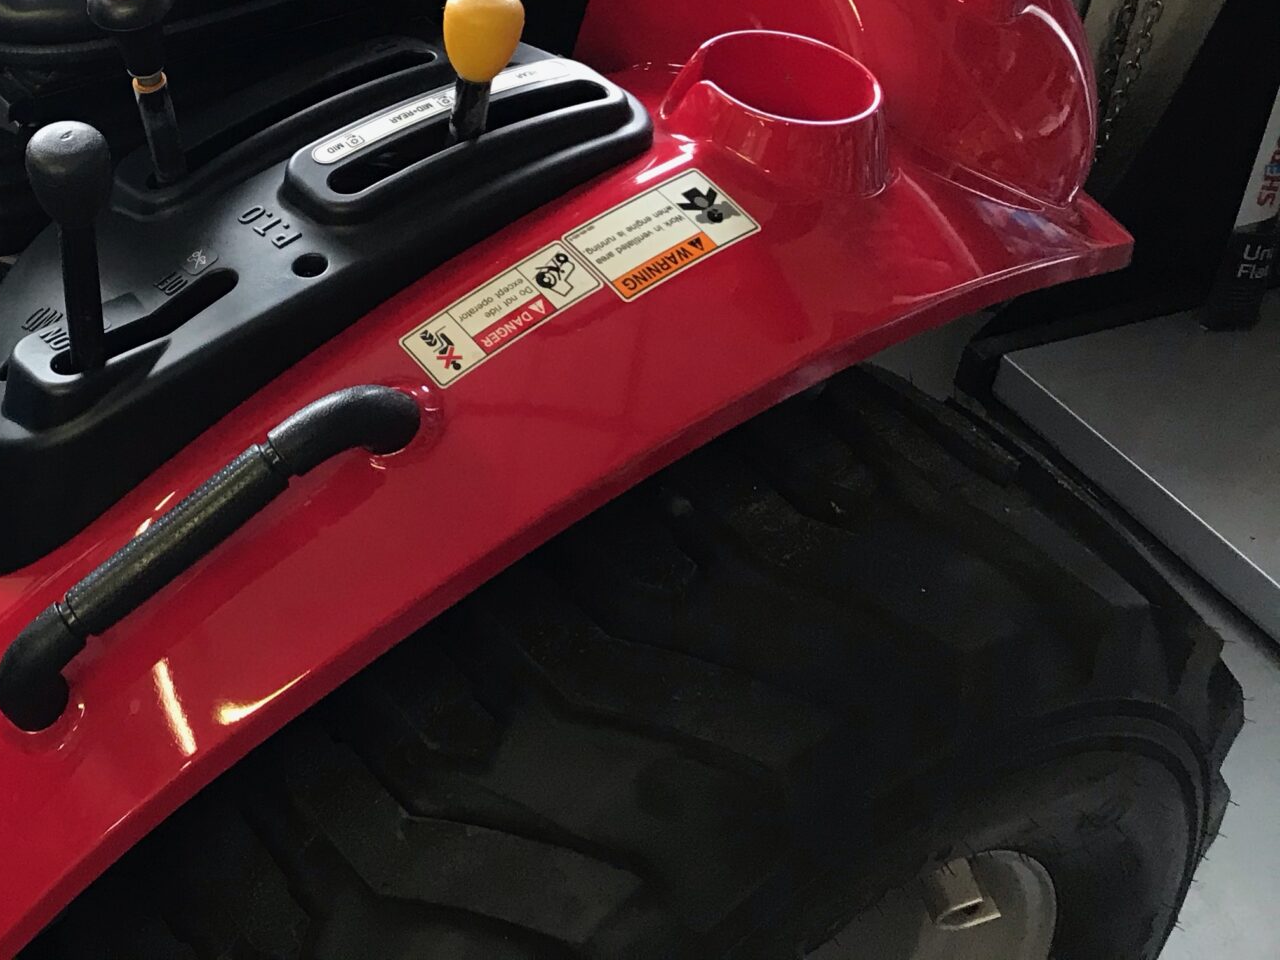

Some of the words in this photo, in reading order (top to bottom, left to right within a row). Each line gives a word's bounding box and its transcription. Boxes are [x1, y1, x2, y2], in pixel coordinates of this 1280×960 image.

[388, 102, 434, 124] MID+REAR
[326, 142, 345, 154] MID
[652, 205, 673, 218] when
[625, 216, 652, 232] engine
[664, 214, 685, 227] Work
[617, 230, 626, 238] is
[653, 223, 664, 233] in
[583, 235, 616, 255] running.
[615, 230, 653, 254] ventilated
[595, 251, 615, 265] area
[622, 246, 694, 291] WARNING
[494, 278, 524, 299] except
[518, 286, 534, 297] Do
[502, 295, 518, 307] not
[458, 296, 494, 322] operator
[484, 304, 502, 318] ride
[480, 310, 534, 348] DANGER
